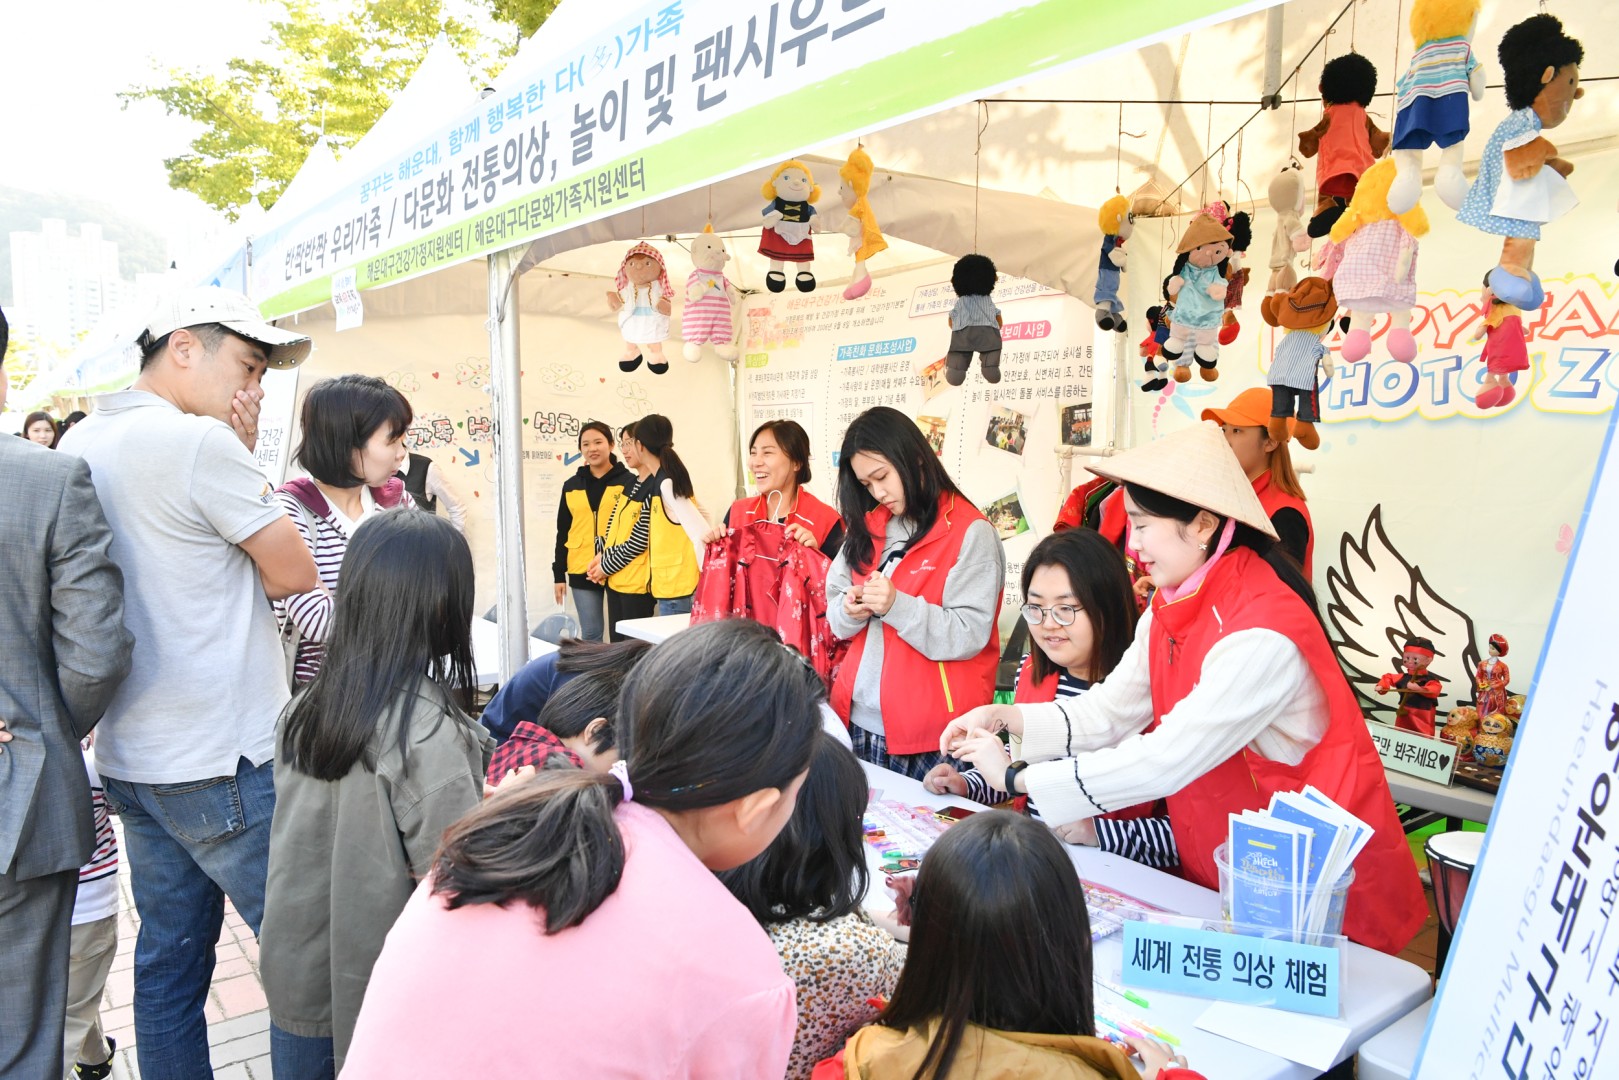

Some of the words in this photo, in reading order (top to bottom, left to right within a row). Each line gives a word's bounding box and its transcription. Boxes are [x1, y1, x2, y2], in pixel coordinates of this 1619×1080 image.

[360, 171, 394, 204] 꿈꾸는
[397, 144, 443, 181] 해운대,
[448, 120, 480, 154] 함께
[487, 79, 546, 135] 행복한
[285, 230, 328, 281] 반짝반짝
[330, 205, 382, 264] 우리가족
[387, 198, 398, 239] /
[403, 169, 455, 231] 다문화
[460, 120, 558, 212] 전통의상,
[569, 80, 630, 167] 놀이
[643, 54, 678, 136] 및
[366, 228, 465, 283] 해운대구건강가정지원센터
[473, 157, 647, 247] 해운대구다문화가족지원센터
[1024, 321, 1046, 338] 사업
[839, 345, 867, 359] 가족친화
[867, 338, 913, 357] 문화조성사업
[1011, 351, 1030, 364] 가정에
[1033, 349, 1060, 363] 파견되어
[1003, 368, 1031, 382] 안전보호,
[1034, 367, 1061, 381] 신변처리
[984, 389, 991, 401] 등
[993, 387, 1017, 401] 일시적인
[1019, 387, 1033, 400] 돌봄
[1035, 385, 1061, 399] 서비스를
[1062, 384, 1088, 398] 공하는
[407, 419, 454, 446] 가족
[1497, 679, 1608, 943] Haeundaegu
[1131, 937, 1172, 975] 세계
[1181, 943, 1224, 981] 전통
[1232, 950, 1276, 989] 의상
[1284, 957, 1328, 998] 체험
